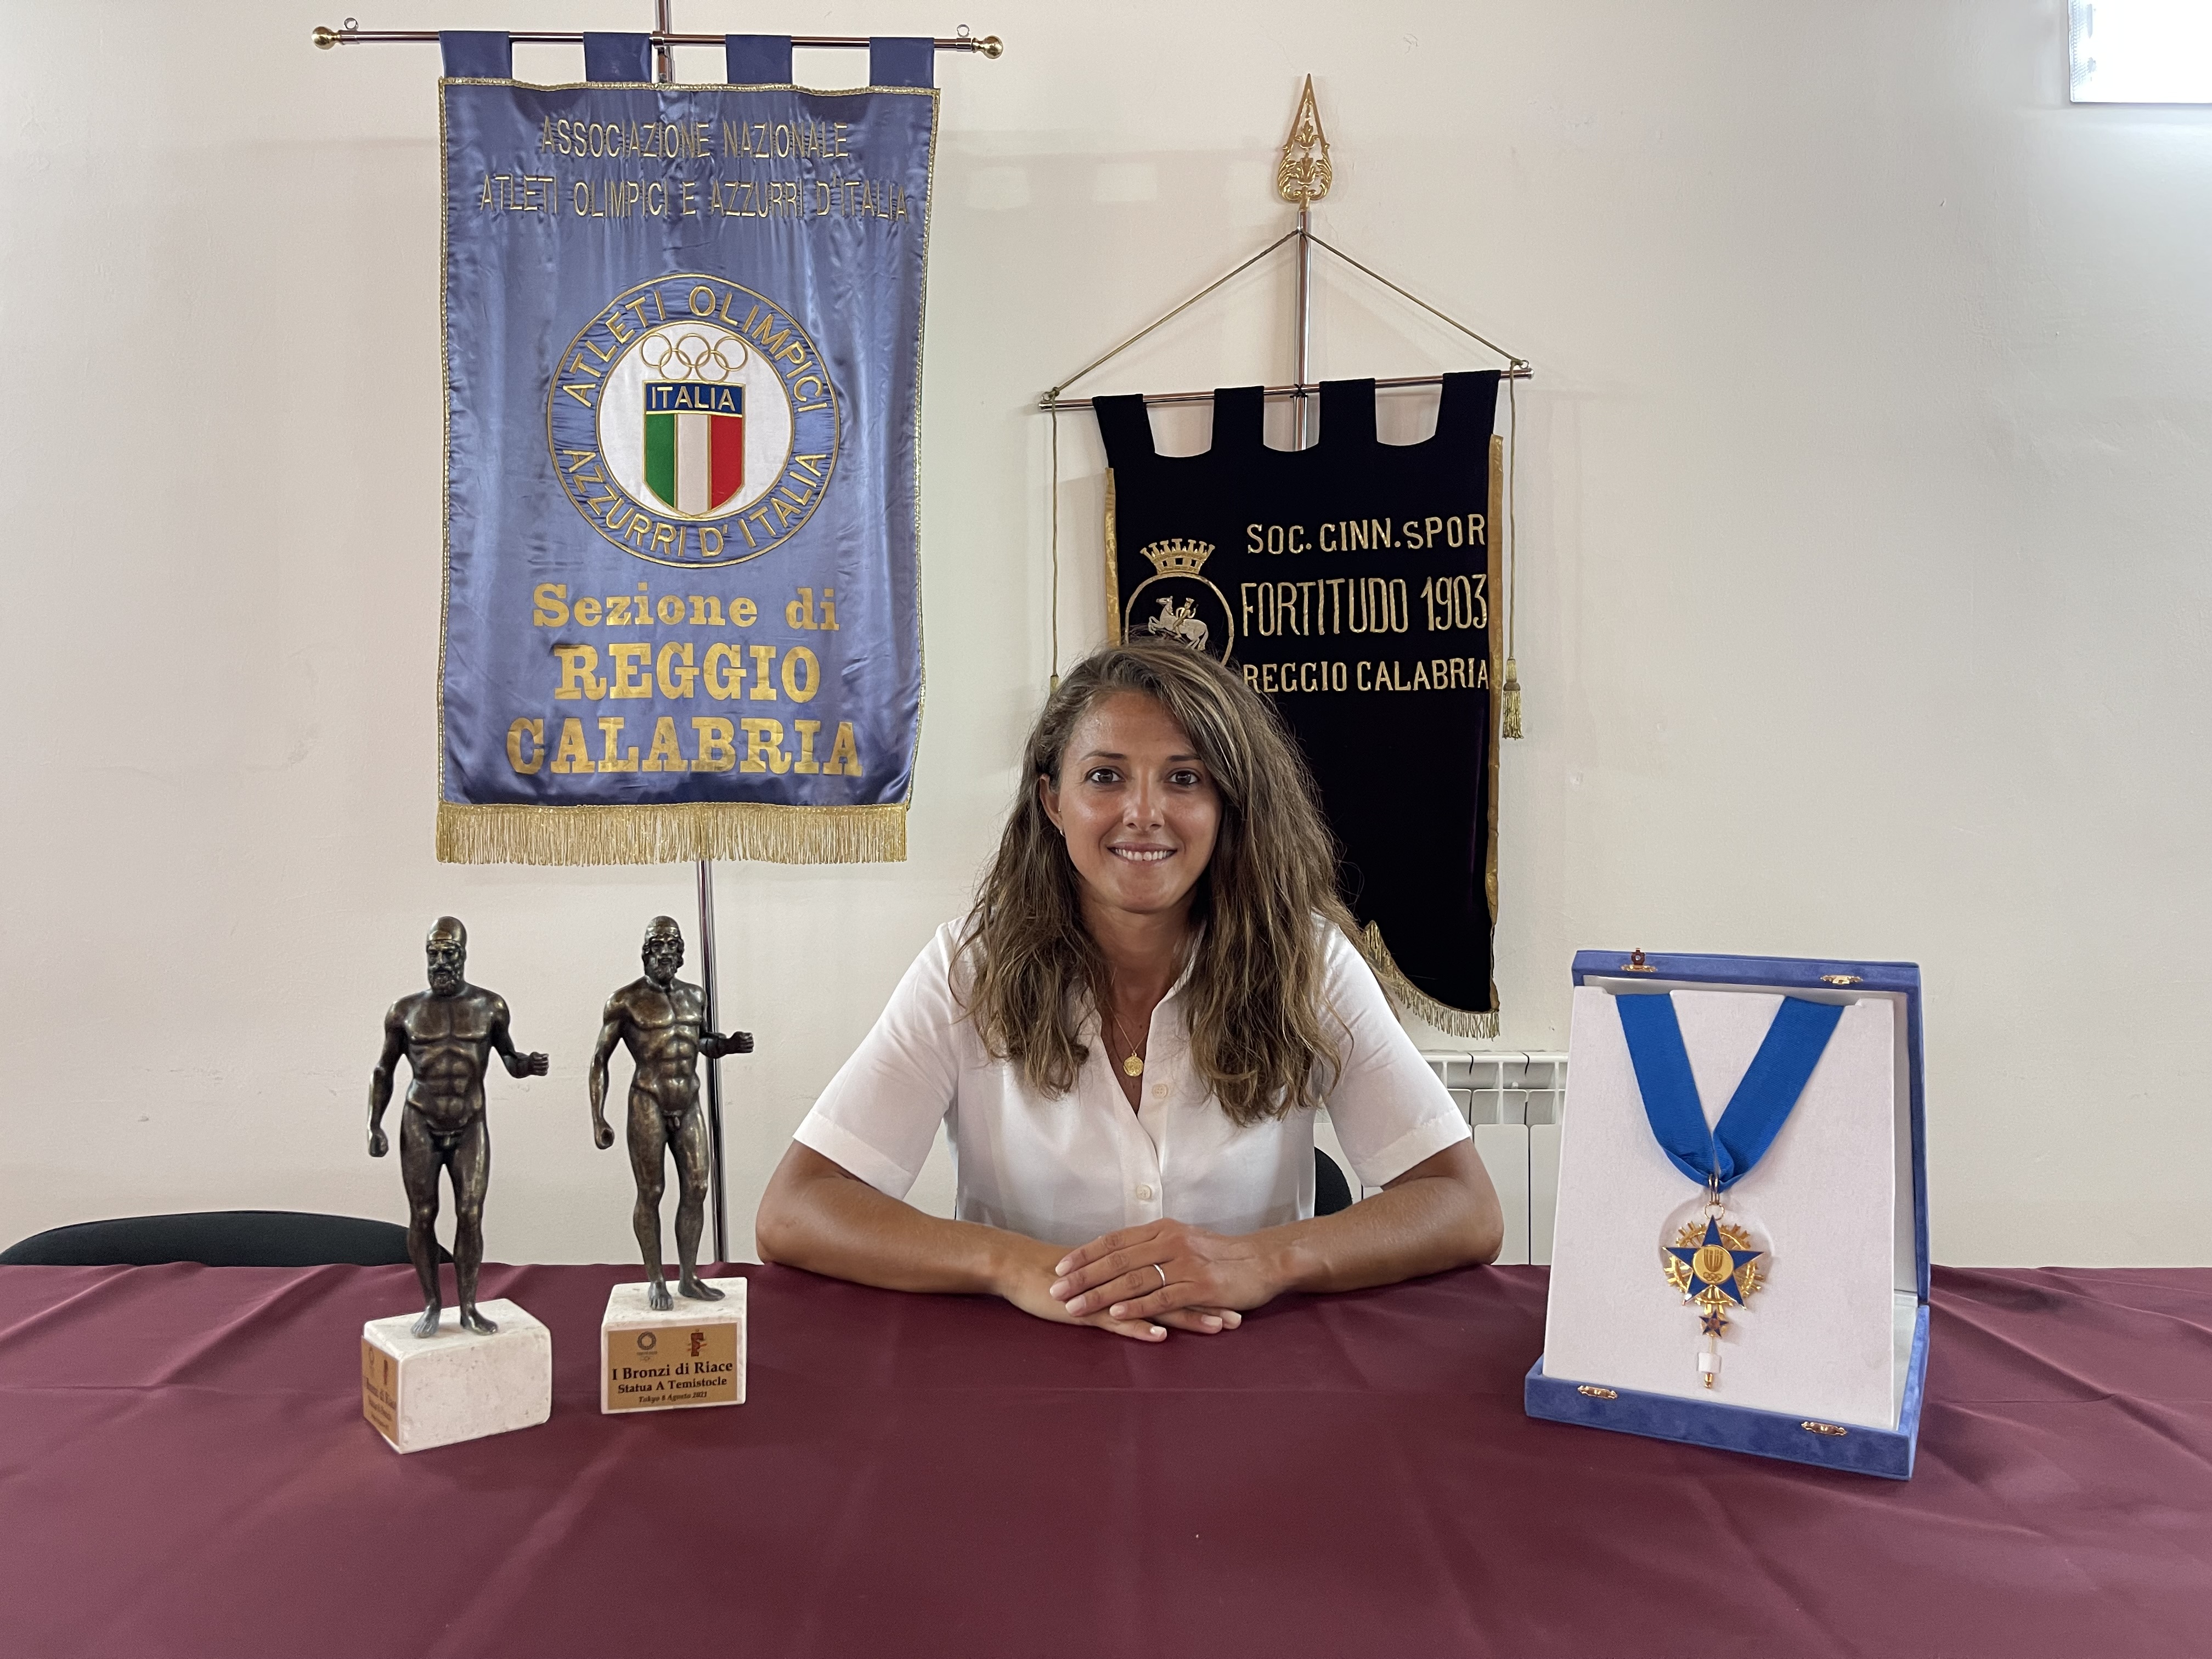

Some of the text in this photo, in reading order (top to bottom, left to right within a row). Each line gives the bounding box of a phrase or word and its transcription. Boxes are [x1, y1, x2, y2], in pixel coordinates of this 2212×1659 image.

[541, 115, 848, 158] ASSOCIAZIONE NAZIONALE
[481, 171, 909, 223] ATLETI OLIMPICI E AZZURRI D'ITALIA
[562, 286, 828, 412] ATLETI OLIMPICI
[652, 386, 736, 412] ITALIA
[562, 450, 687, 557] AZZURRI
[1247, 524, 1312, 554] SOC.
[533, 582, 840, 630] Sezione di
[1240, 573, 1488, 636] FORTITUDO 1903
[554, 641, 821, 703] REGGIO
[1243, 657, 1489, 693] REGGIO CALABRIA
[506, 716, 862, 776] CALABRIA
[612, 1361, 733, 1380] I Bronzi di Riace
[618, 1376, 727, 1394] Statua A Temistocle
